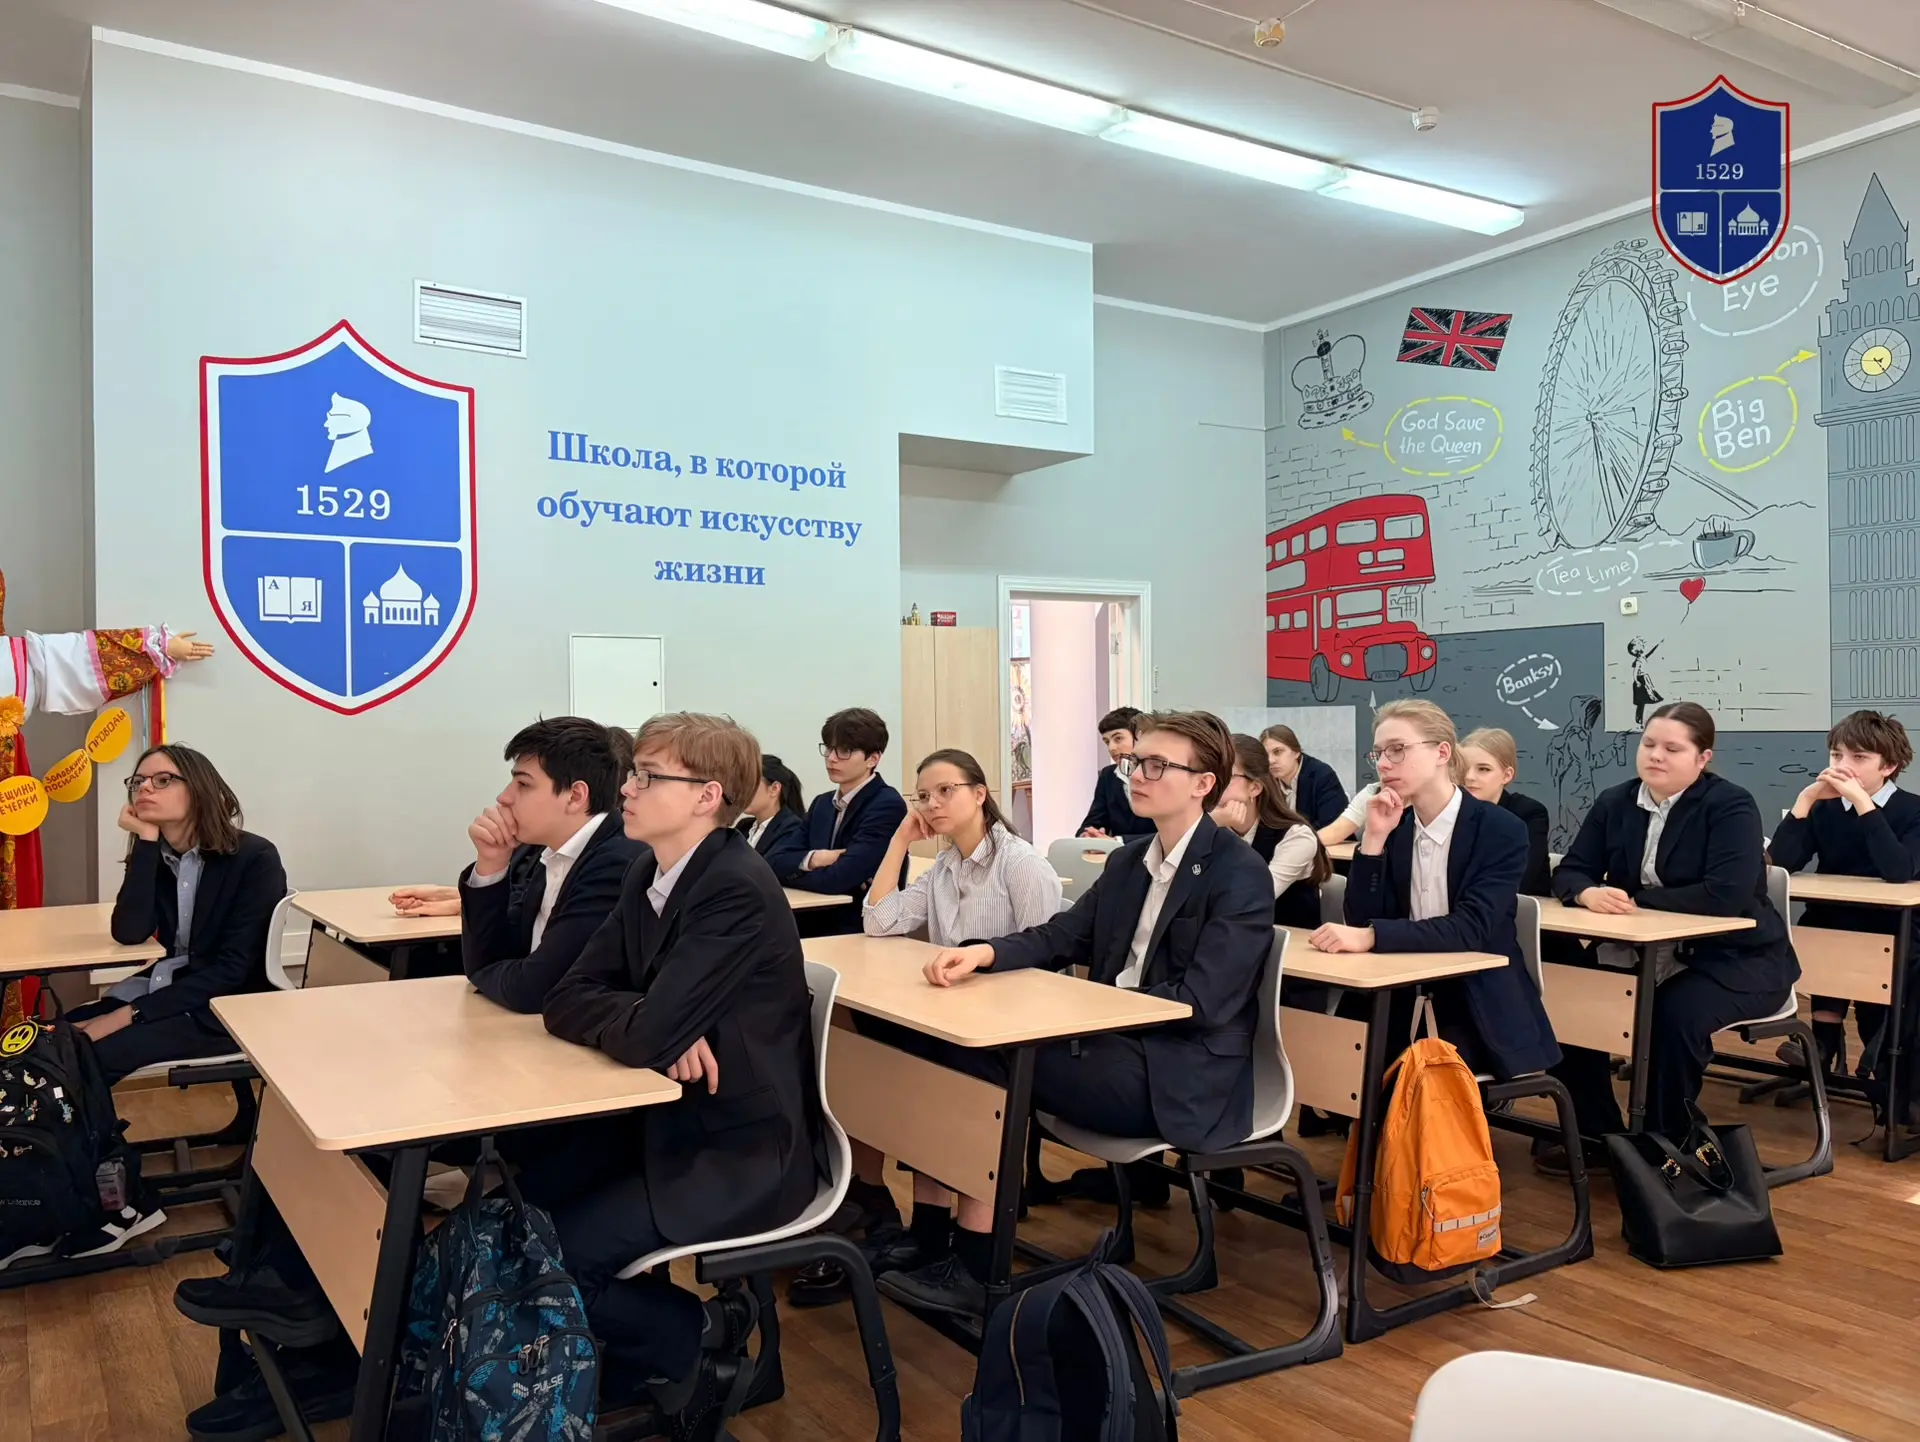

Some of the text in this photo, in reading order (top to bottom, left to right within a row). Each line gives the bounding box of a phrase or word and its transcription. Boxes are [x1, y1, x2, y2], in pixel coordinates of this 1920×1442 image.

[1723, 274, 1779, 311] Eye
[1401, 410, 1486, 432] God Save
[1712, 398, 1765, 431] Big
[1400, 434, 1482, 455] the Queen
[1714, 424, 1771, 459] Ben
[548, 430, 847, 491] Школа, в которой
[296, 485, 391, 520] 1529
[537, 489, 863, 547] обучают искусству
[268, 579, 280, 590] А
[654, 560, 766, 586] жизни
[1547, 564, 1581, 585] Tea
[301, 600, 313, 612] Я
[1502, 663, 1553, 694] Banksy
[87, 710, 126, 753] ПРОВОДЫ
[0, 793, 39, 815] ЕЧЕРКИ
[532, 1373, 564, 1394] PULSE
